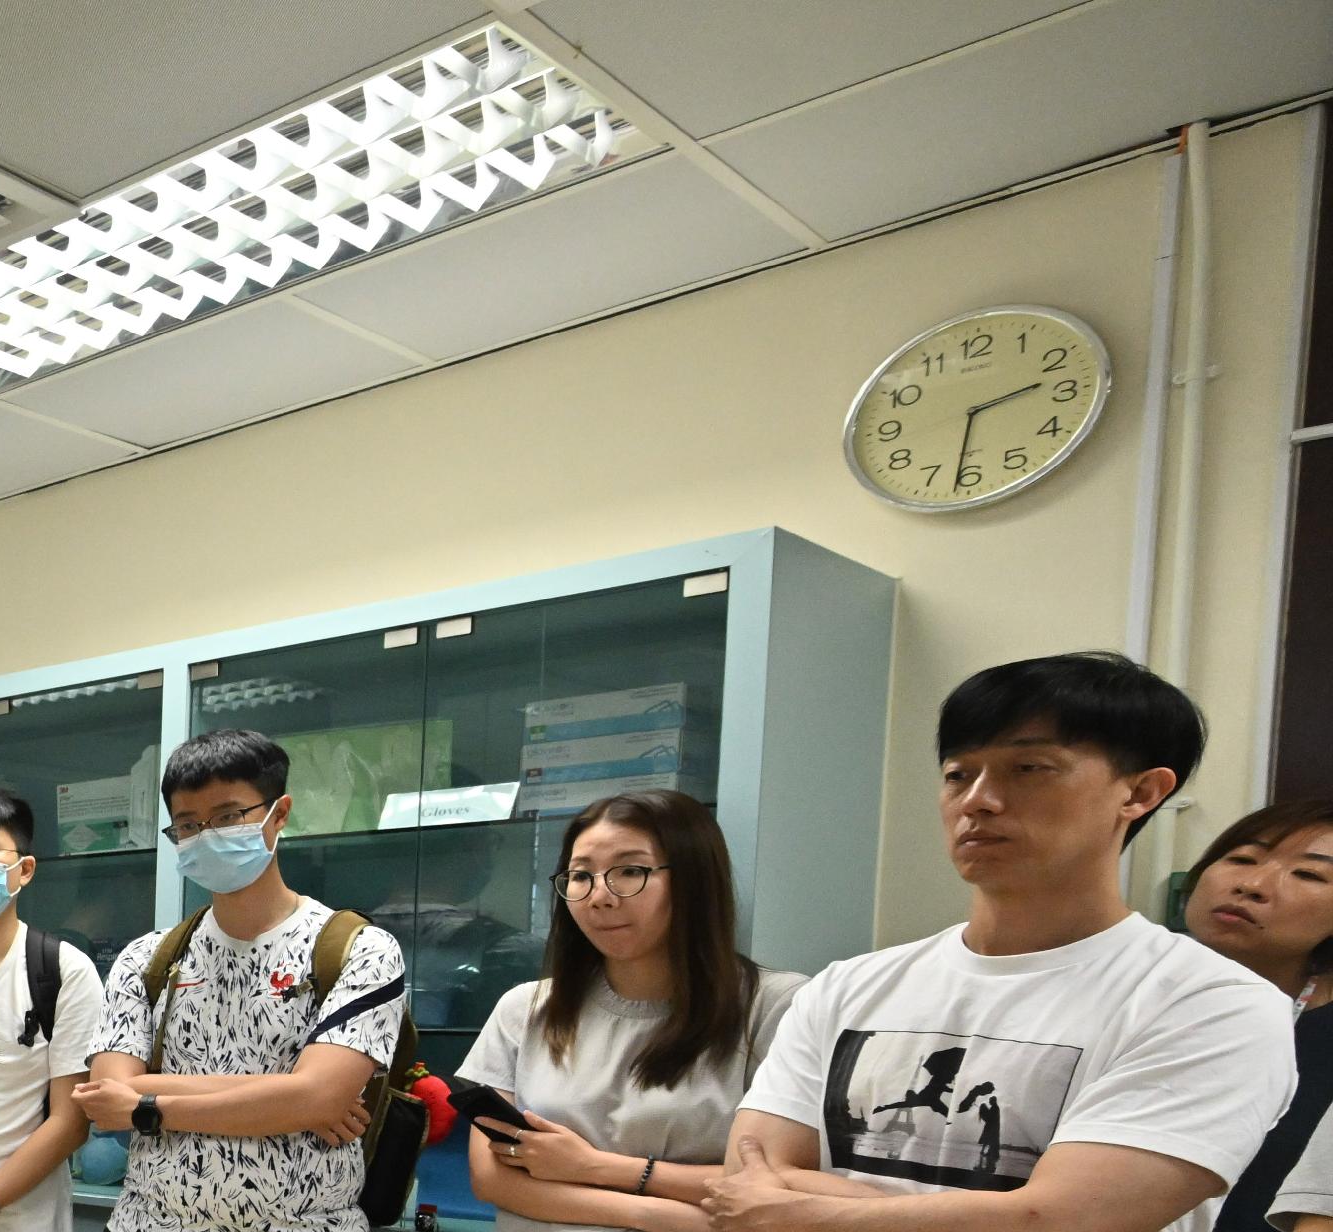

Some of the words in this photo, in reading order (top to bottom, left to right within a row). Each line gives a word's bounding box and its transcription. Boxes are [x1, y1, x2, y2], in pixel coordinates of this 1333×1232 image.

[960, 334, 993, 360] 12
[1017, 332, 1026, 354] 1
[921, 352, 944, 377] 11
[1041, 347, 1068, 373] 2
[889, 384, 922, 409] 10
[1052, 379, 1078, 402] 3
[878, 420, 902, 442] 9
[1036, 415, 1063, 438] 4
[888, 449, 912, 471] 8
[1003, 447, 1028, 470] 5
[920, 464, 942, 487] 7
[957, 465, 983, 487] 6
[421, 805, 470, 818] Gloves
